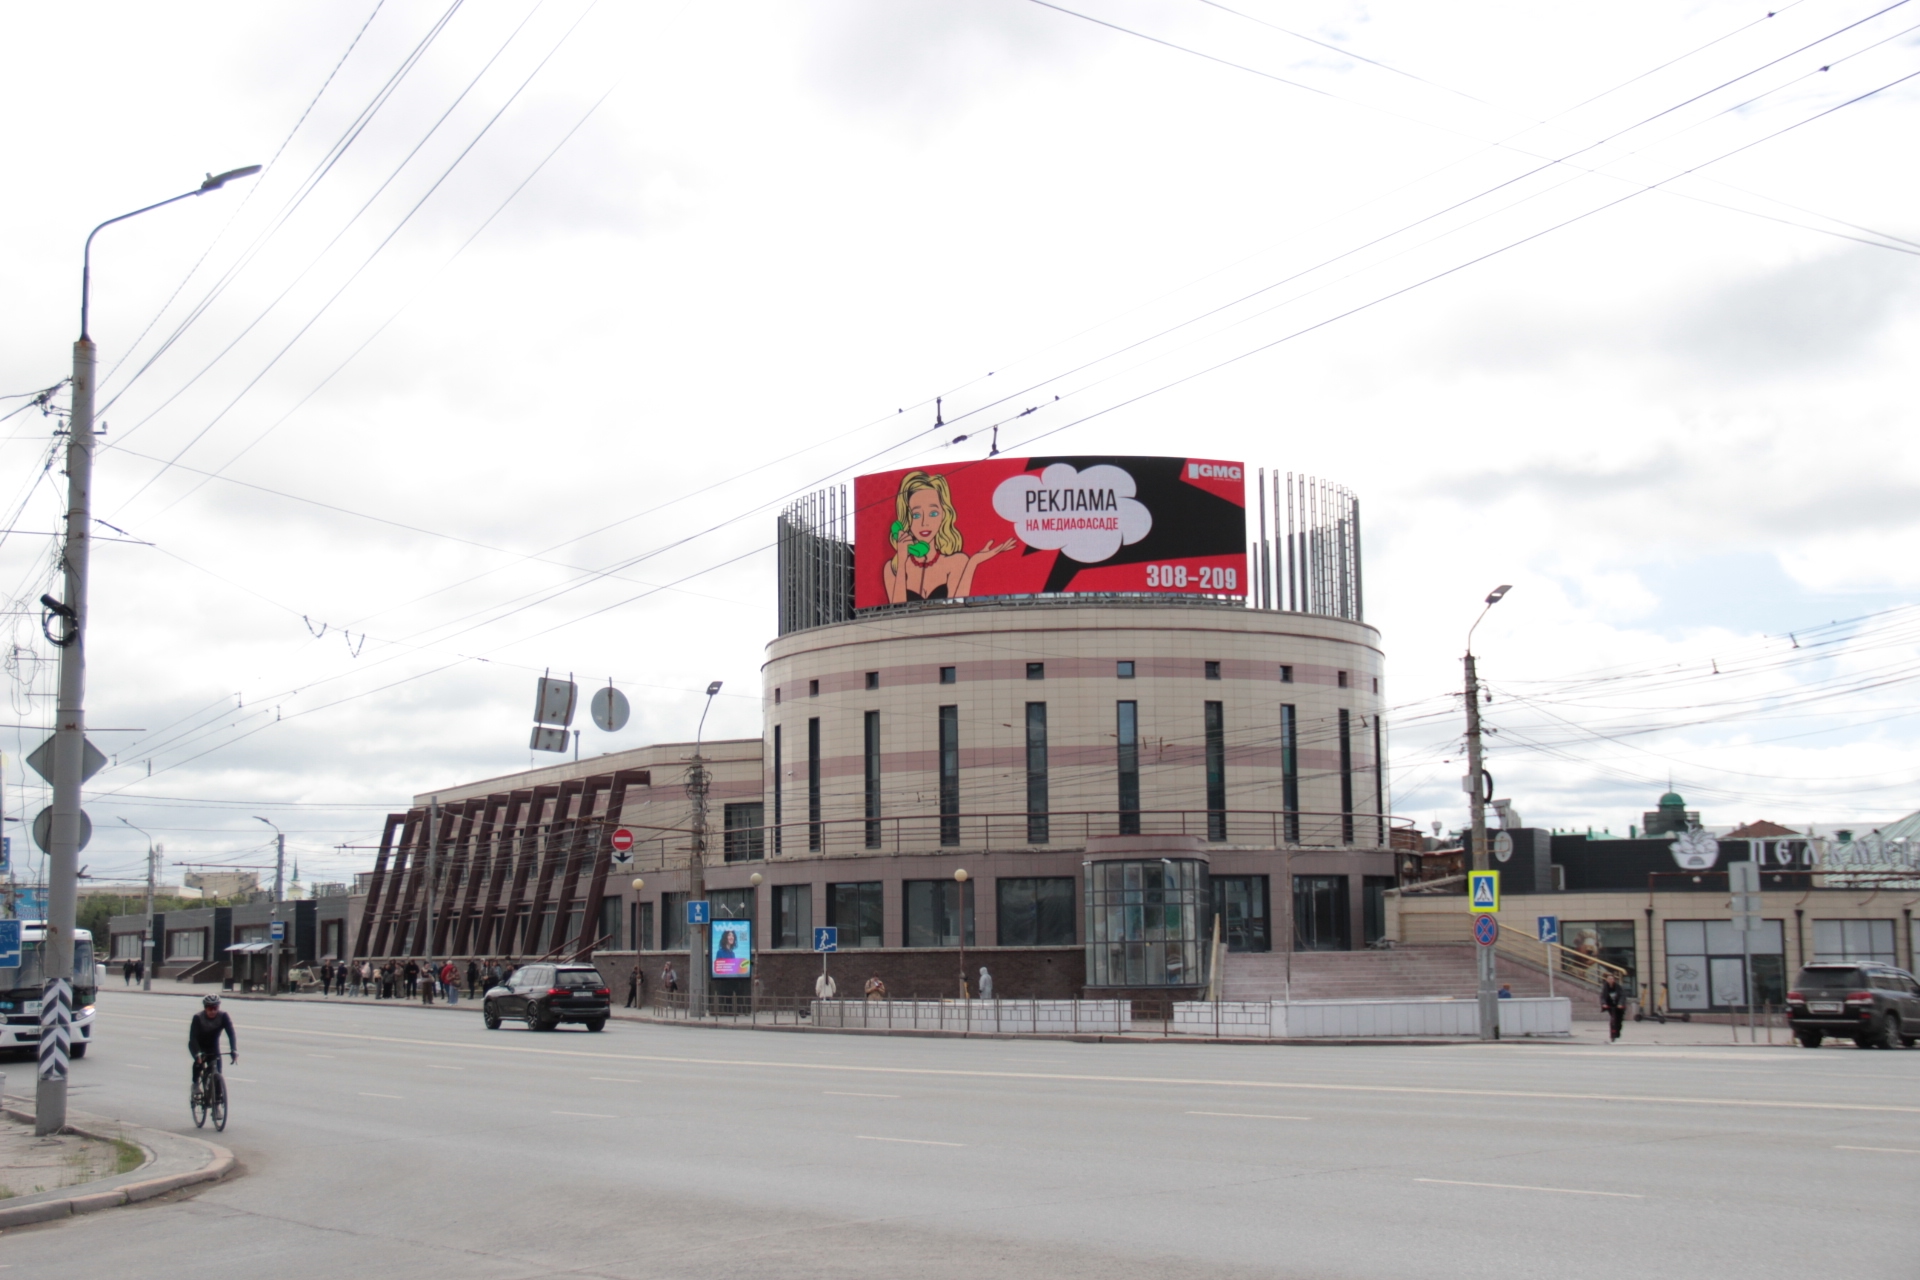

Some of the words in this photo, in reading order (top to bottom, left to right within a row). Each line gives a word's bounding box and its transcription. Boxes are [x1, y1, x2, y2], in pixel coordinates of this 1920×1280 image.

[1199, 464, 1242, 479] GMG
[1026, 488, 1118, 512] РЕКЛАМА
[1026, 519, 1039, 531] НА
[1041, 517, 1118, 531] МЕДИАФАСАДЕ
[1146, 565, 1237, 590] 308-209
